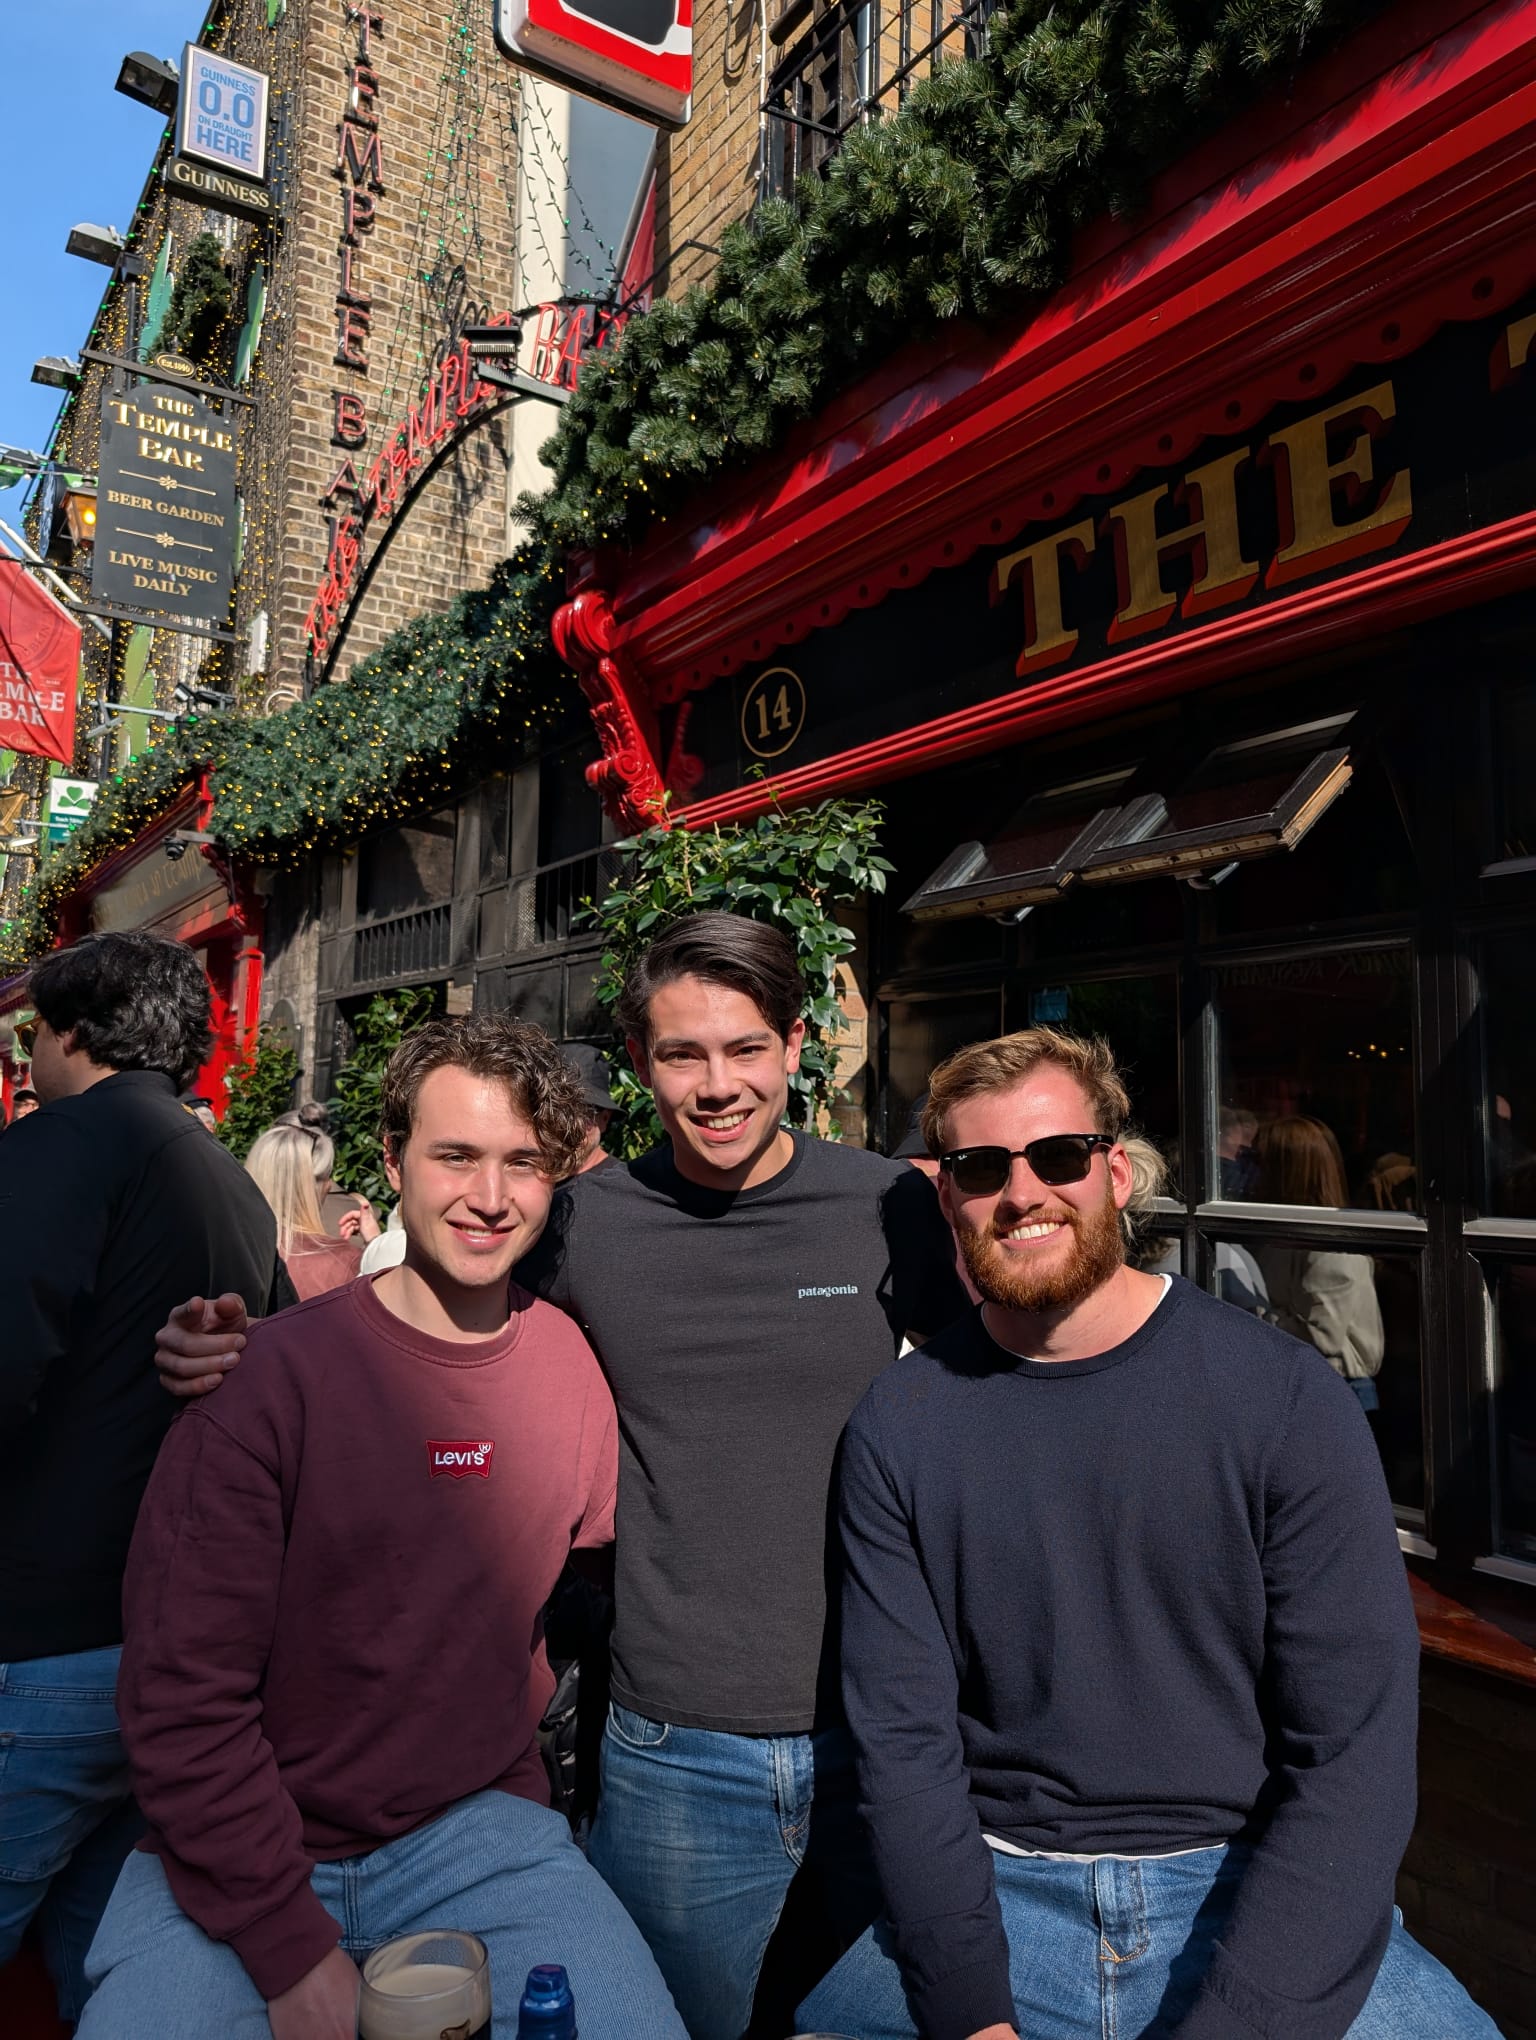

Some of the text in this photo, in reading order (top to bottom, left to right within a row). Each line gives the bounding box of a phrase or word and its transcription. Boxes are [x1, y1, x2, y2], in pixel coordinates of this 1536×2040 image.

[200, 66, 256, 97] GUINNESS
[199, 80, 255, 129] 0.0
[196, 125, 254, 162] HERE
[198, 114, 253, 141] ON DRAUGHT
[173, 162, 271, 209] GUINNESS
[331, 6, 388, 374] TEMPLE
[152, 394, 195, 417] THE
[366, 310, 512, 520] TEMPL
[108, 399, 233, 453] TEMPLE
[138, 435, 206, 473] BAR
[106, 489, 225, 528] BEER GARDEN
[998, 379, 1412, 660] THE
[108, 549, 218, 584] LIVE MUSIC
[133, 573, 193, 597] DAILY
[755, 684, 793, 739] 14
[797, 1284, 859, 1299] patagonia
